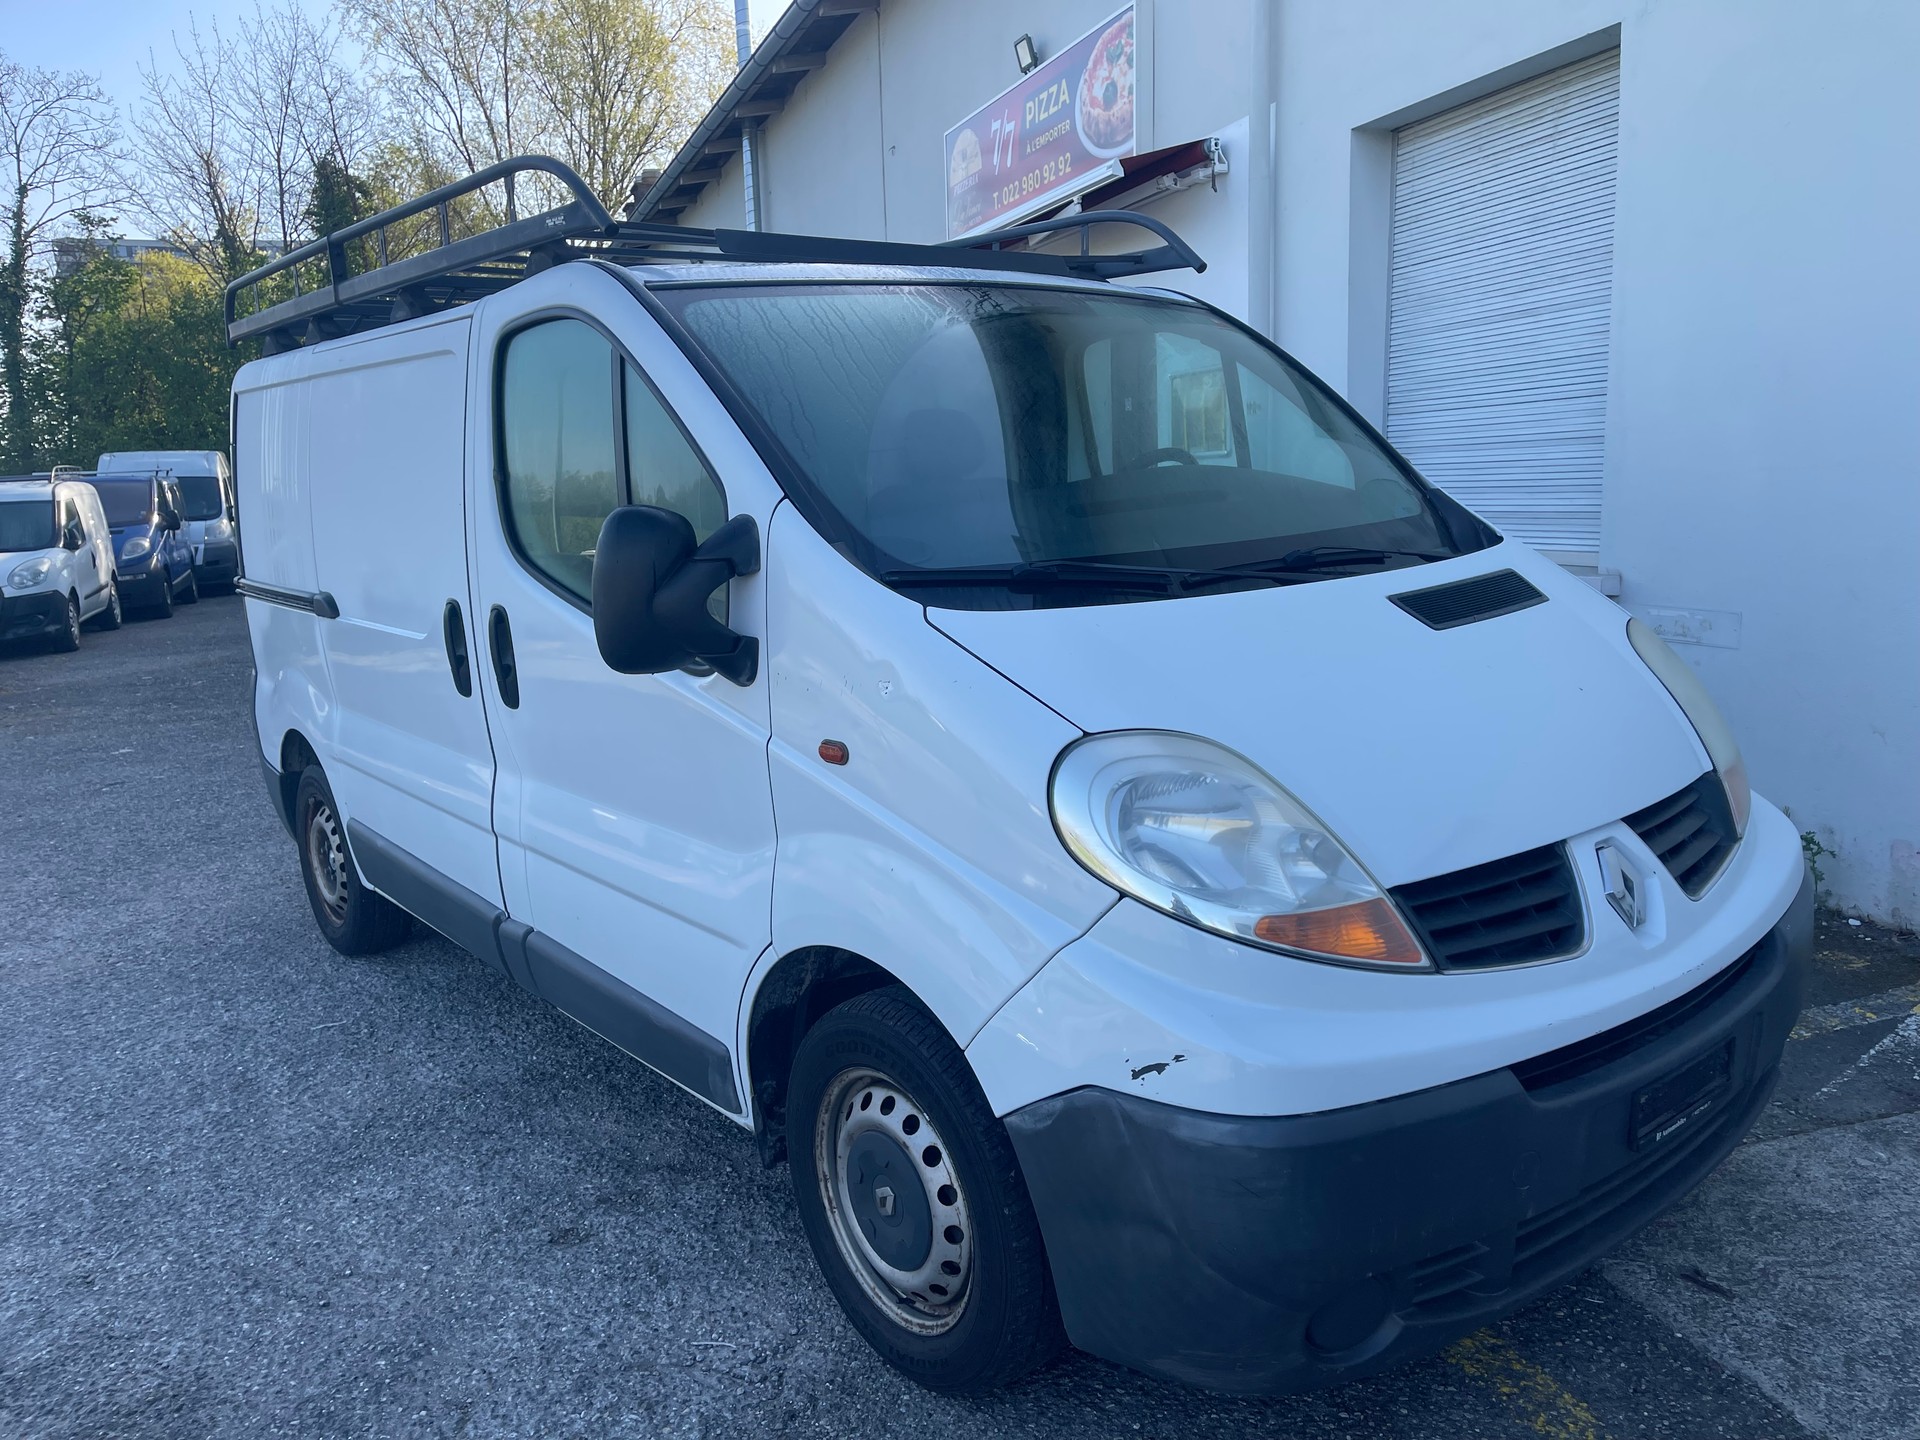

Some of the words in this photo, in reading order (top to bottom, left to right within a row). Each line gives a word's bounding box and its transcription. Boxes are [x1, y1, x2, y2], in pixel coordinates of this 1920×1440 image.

[1026, 78, 1070, 129] PIZZA
[1032, 119, 1071, 151] L'EMPORTER
[992, 191, 1001, 210] T.
[1002, 181, 1020, 205] 022
[1022, 169, 1041, 195] 980
[1043, 161, 1056, 184] 92
[1058, 152, 1072, 176] 92
